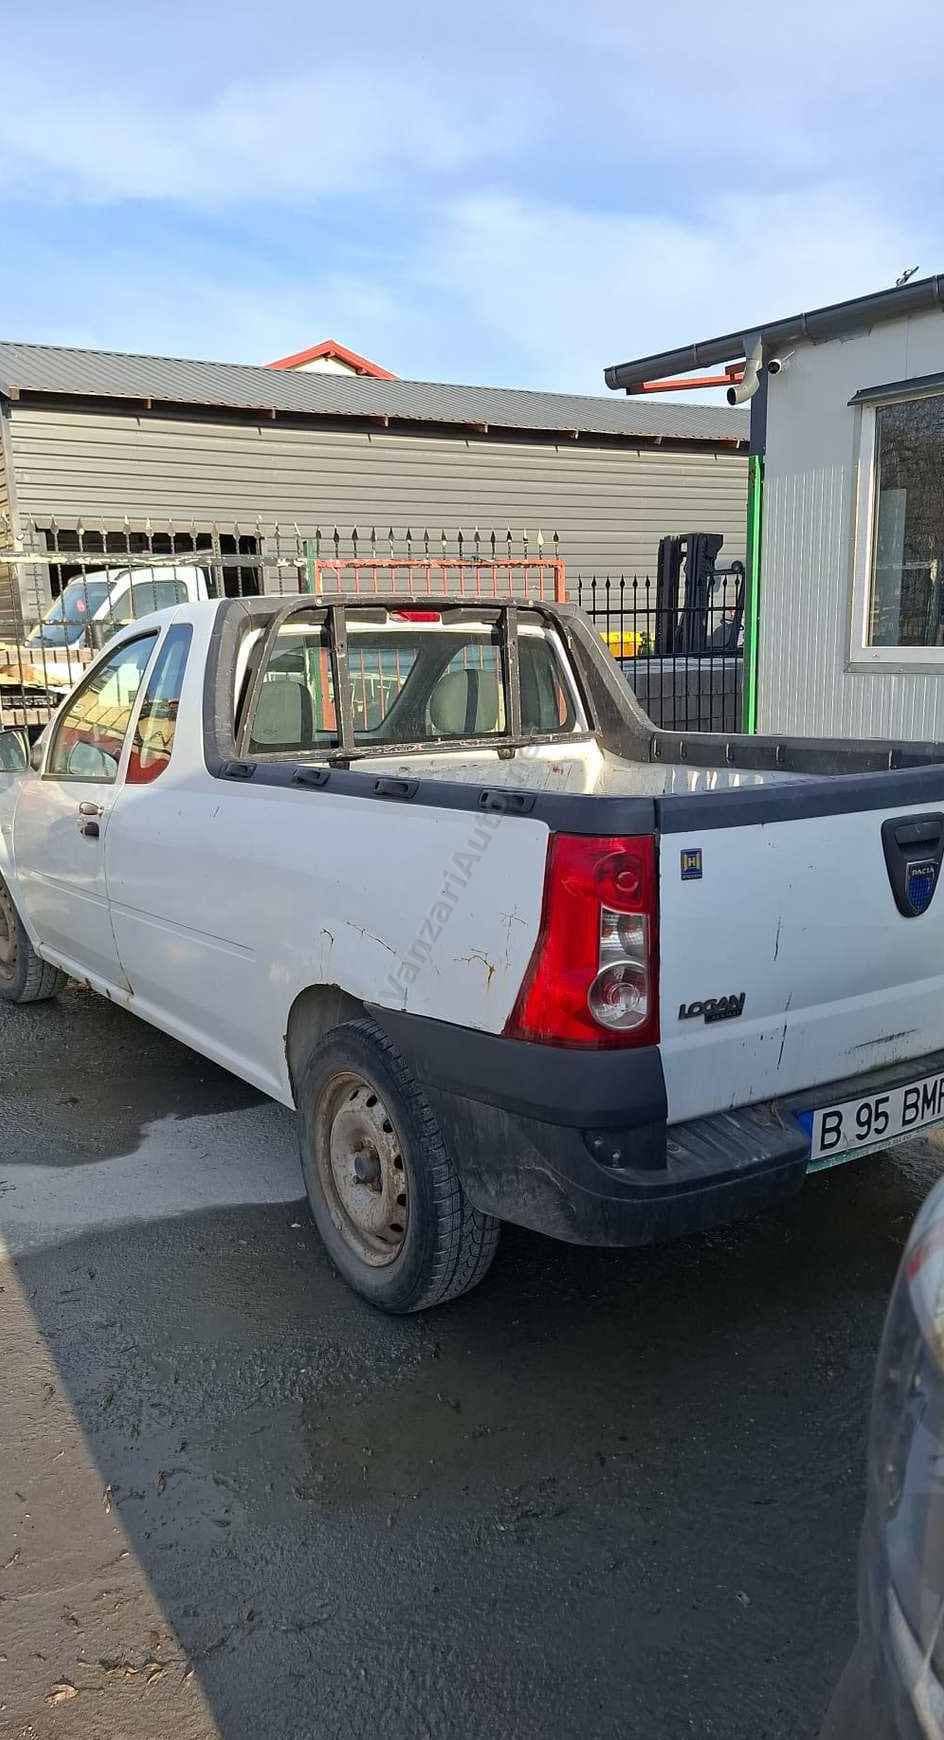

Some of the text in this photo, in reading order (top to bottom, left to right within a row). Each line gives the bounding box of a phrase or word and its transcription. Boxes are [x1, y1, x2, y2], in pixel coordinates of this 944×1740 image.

[911, 867, 935, 876] DACIA
[678, 992, 746, 1021] LOGAN
[820, 1110, 843, 1151] B
[855, 1095, 890, 1141] 95
